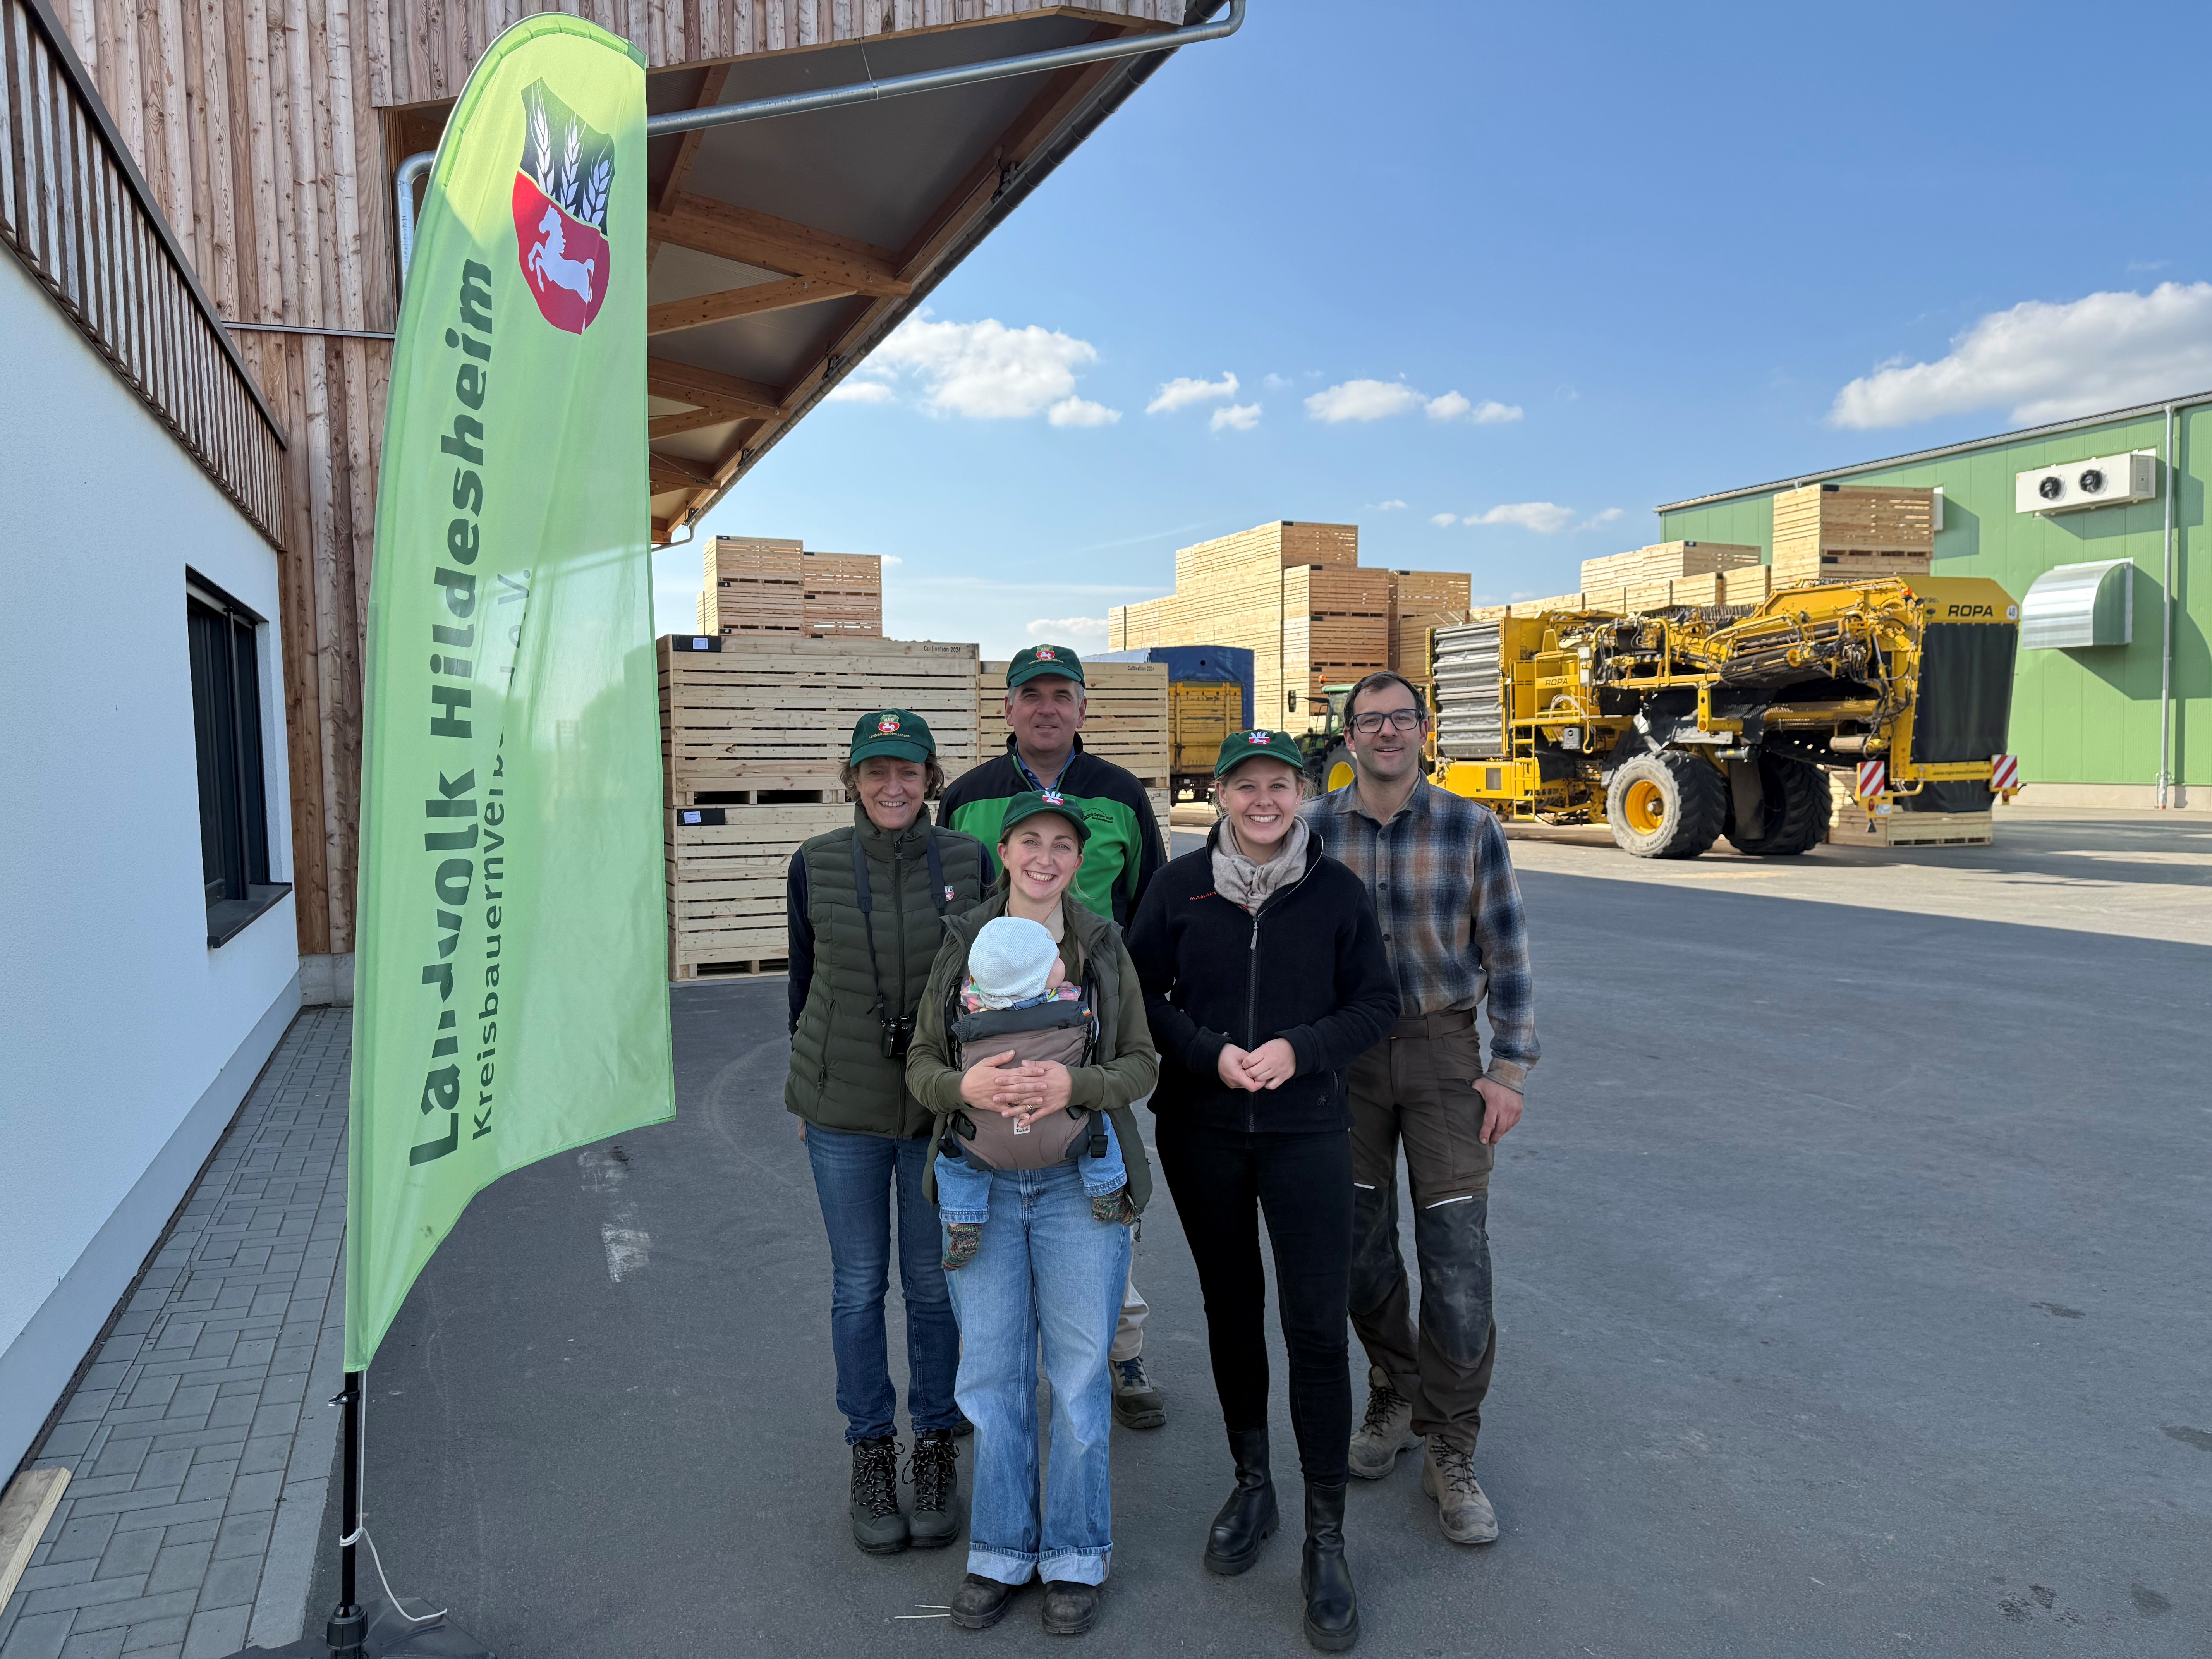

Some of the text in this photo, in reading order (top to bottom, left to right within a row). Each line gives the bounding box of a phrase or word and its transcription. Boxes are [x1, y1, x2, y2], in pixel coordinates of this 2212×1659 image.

[430, 259, 493, 739] Hildesheim
[1948, 605, 1993, 617] ROPA
[1545, 678, 1568, 686] ROPA
[1190, 891, 1218, 901] MAMMUT
[472, 665, 515, 1140] Kreisbauernver
